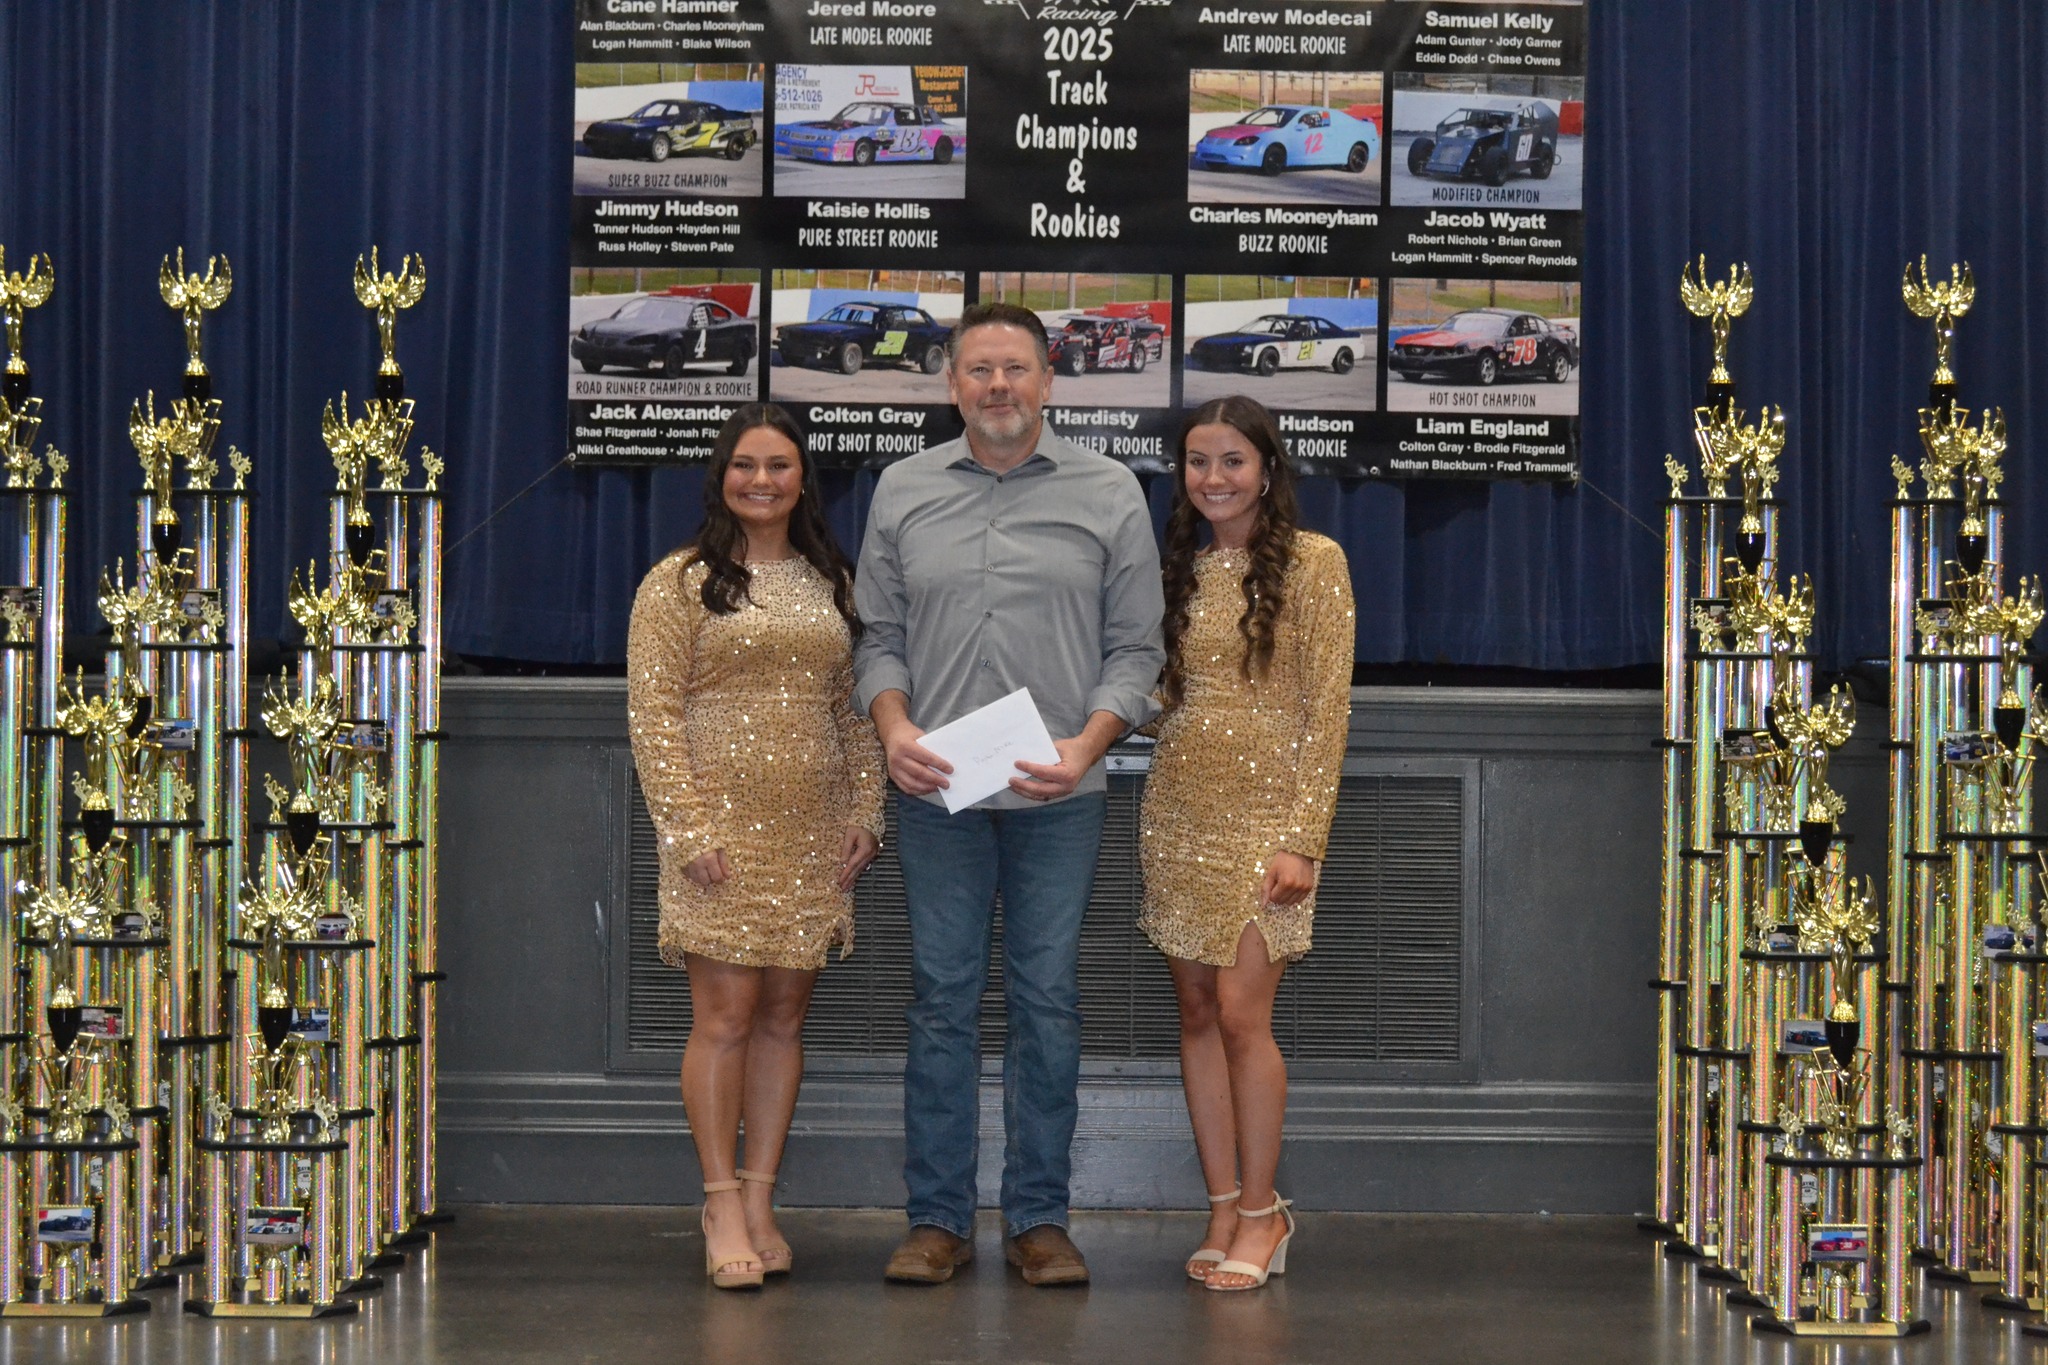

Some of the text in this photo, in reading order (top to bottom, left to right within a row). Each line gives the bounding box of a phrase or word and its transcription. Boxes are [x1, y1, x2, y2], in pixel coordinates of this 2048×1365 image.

[607, 0, 738, 14] Cane Hamner
[807, 1, 936, 17] Jered Moore
[1036, 6, 1118, 26] Racing
[1198, 7, 1372, 26] Andrew Modecai
[580, 20, 764, 34] Alan Blackburn Charles Mooneyham
[1425, 11, 1554, 34] Samuel Kelly
[592, 38, 751, 51] Logan Hammitt Blake Wilson
[810, 26, 932, 46] LATE MODEL ROOKIE
[1044, 26, 1113, 62] 2025
[1223, 35, 1346, 54] LATE MODEL ROOKIE
[1416, 35, 1562, 49] Adam Gunter Jody Garner
[1416, 52, 1561, 66] Eddie Dodd Chase Owens
[1047, 69, 1108, 105] Track
[1016, 113, 1138, 159] Champions
[1305, 133, 1324, 154] 12
[608, 174, 728, 188] SUPER BUZZ CHAMPION
[1066, 158, 1086, 193] &
[1432, 188, 1540, 203] MODIFIED CHAMPION
[595, 200, 738, 219] Jimmy Hudson
[808, 202, 930, 219] Kaisie Hollis
[1190, 207, 1378, 228] Charles Mooneyham
[1030, 202, 1121, 238] Rookies
[1424, 211, 1546, 232] Jacob Wyatt
[593, 224, 740, 236] Tanner Hudson Hayden Hill
[798, 228, 938, 248] PURE STREET ROOKIE
[598, 242, 734, 254] Russ Holley Steven Pate
[1239, 234, 1328, 254] BUZZ ROOKIE
[1408, 234, 1562, 248] Robert Nichols Brian Green
[1392, 252, 1577, 268] Logan Hammitt Spencer Reynolds
[1297, 341, 1315, 361] 21
[1512, 338, 1537, 366] 78
[576, 381, 751, 396] ROAD RUNNER CHAMPION & ROOKIE
[1430, 392, 1536, 407] HOT SHOT CHAMPION
[590, 404, 637, 420] Jack
[810, 407, 926, 427] Colton Gray
[1055, 409, 1139, 429] Hardisty
[576, 427, 602, 437] Shae
[605, 427, 656, 439] Fitzgerald
[666, 428, 698, 438] Jonah
[1280, 416, 1354, 432] Hudson
[1416, 418, 1549, 439] Liam England
[577, 445, 714, 458] Nikki Greathouse Jaylyn
[808, 433, 925, 452] HOT SHOT ROOKIE
[1113, 437, 1162, 455] ROOKIE
[1298, 439, 1347, 458] ROOKIE
[1400, 441, 1566, 456] Colton Gray Brodie Fitzgerald
[1390, 459, 1574, 472] Nathan Blackburn Fred Trammell
